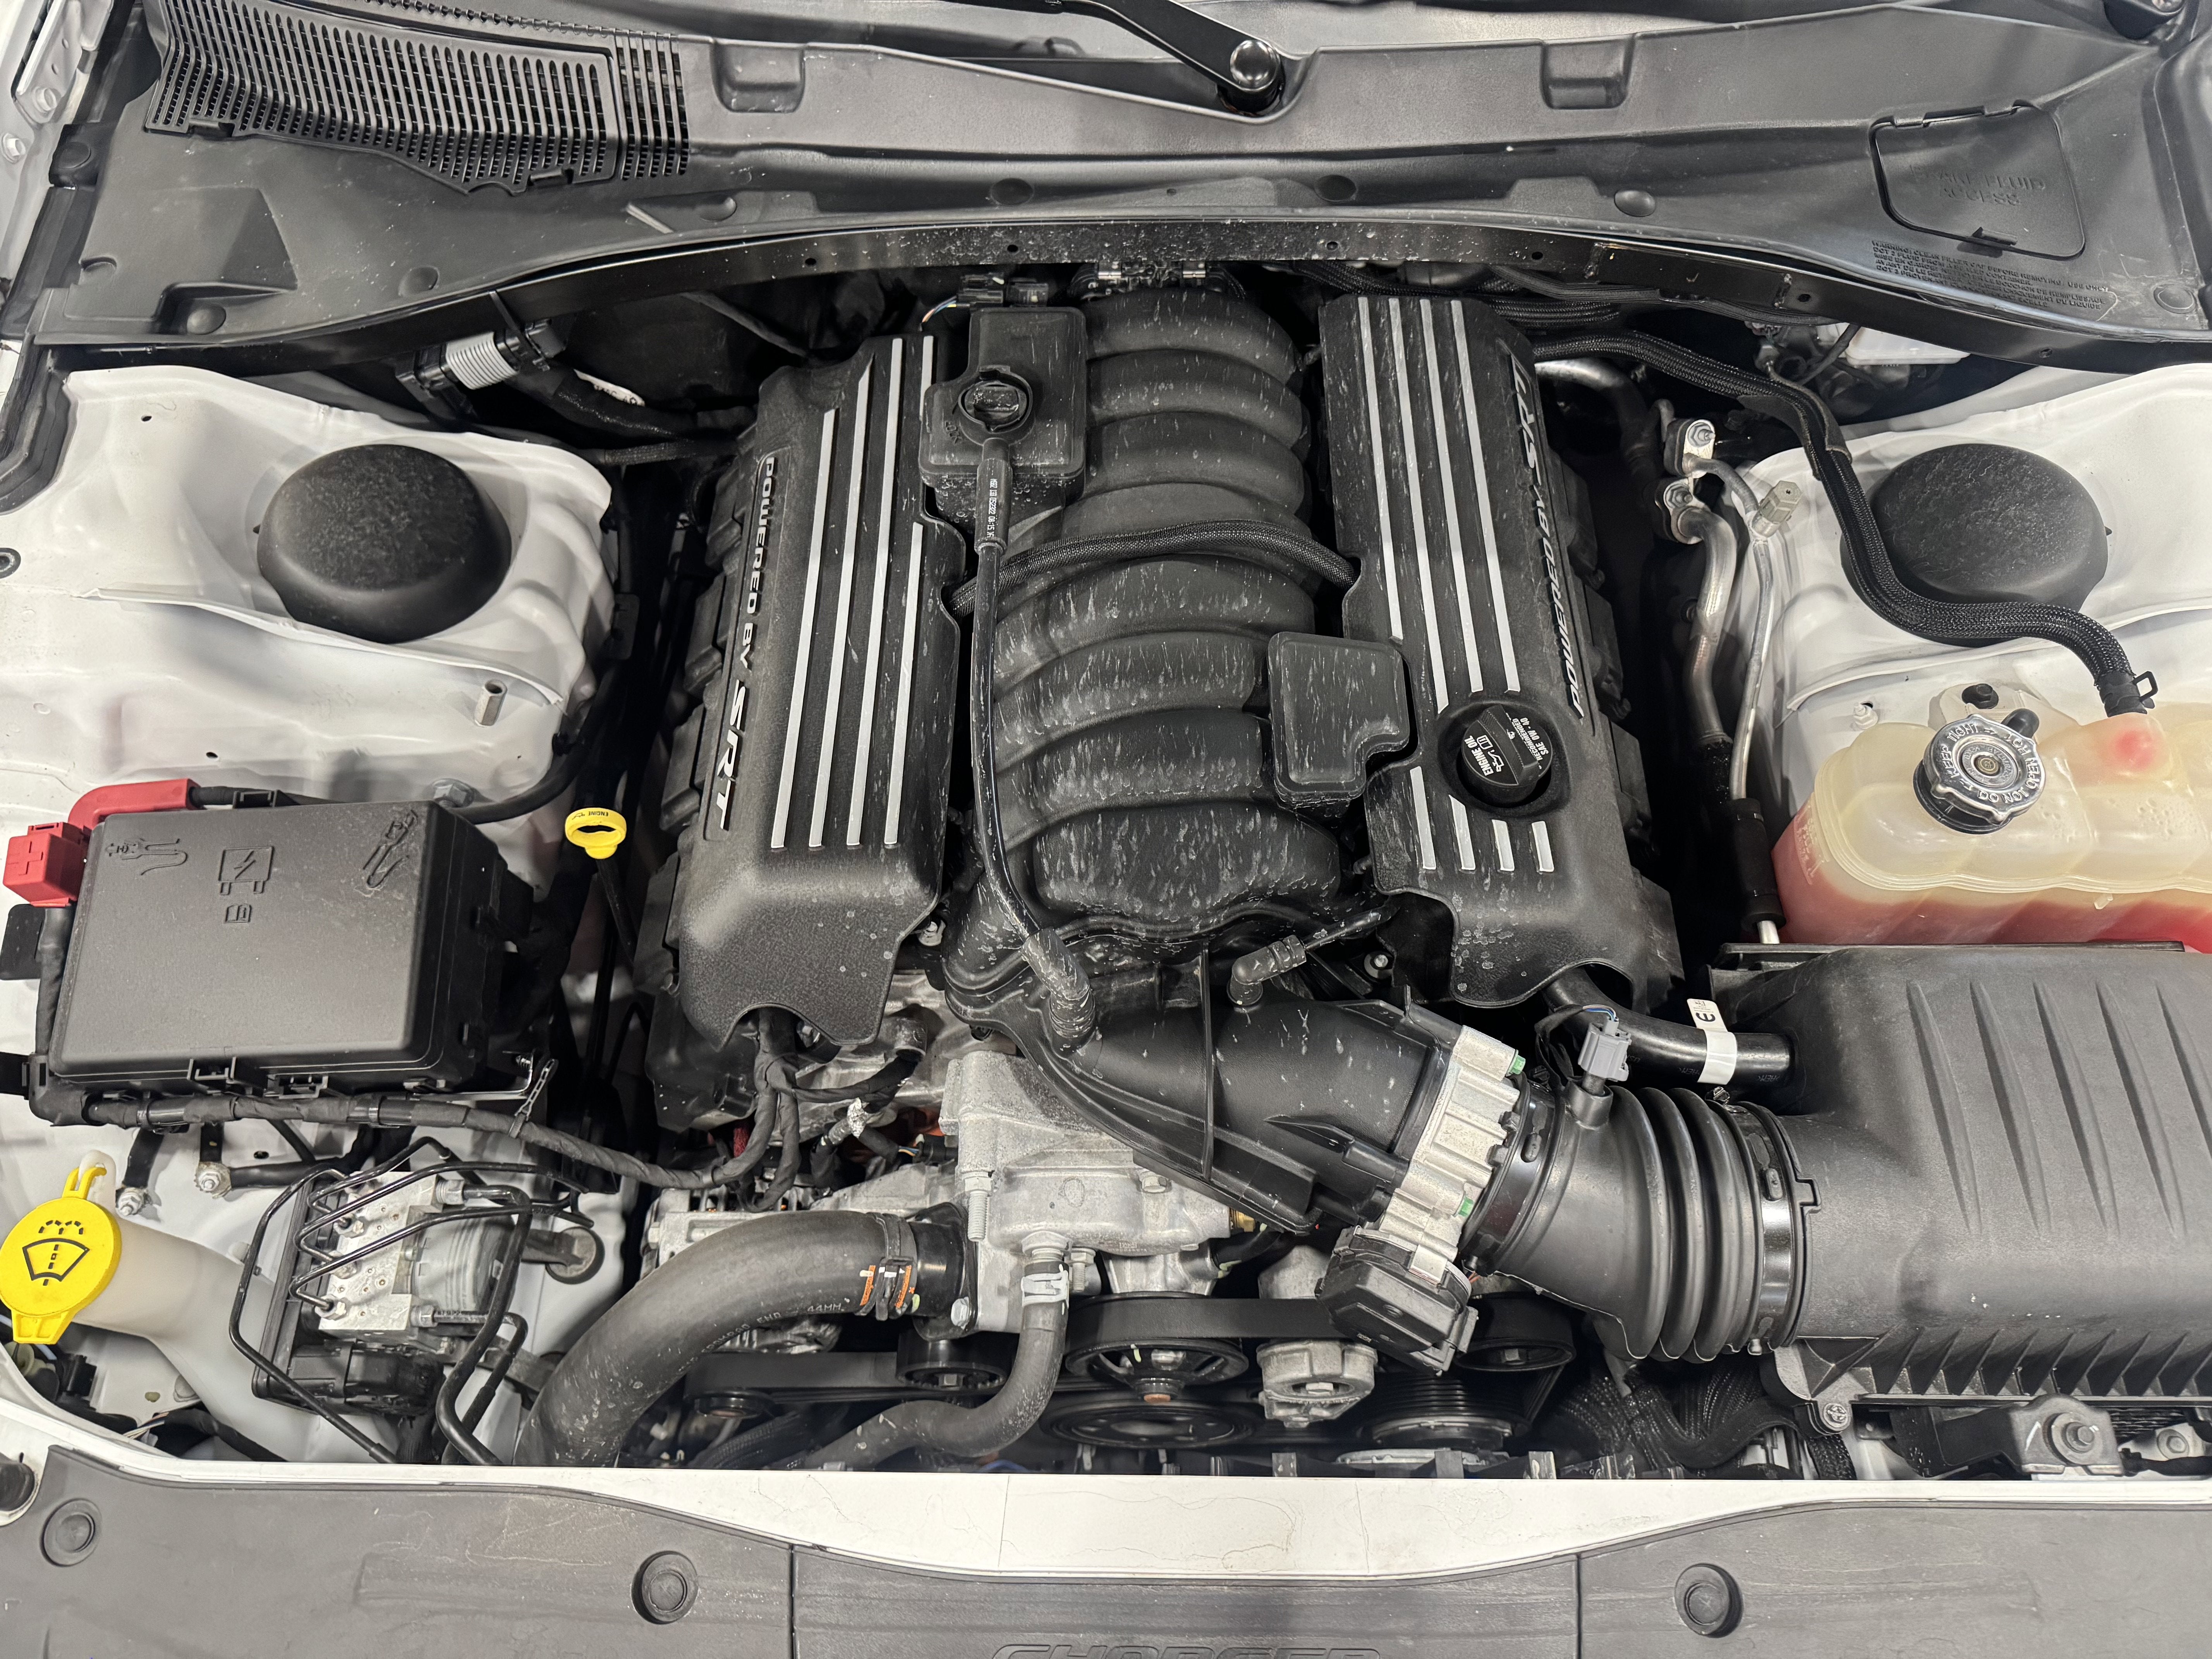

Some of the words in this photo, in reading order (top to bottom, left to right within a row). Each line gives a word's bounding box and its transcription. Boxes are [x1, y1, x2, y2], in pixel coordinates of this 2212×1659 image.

[1985, 175, 2045, 191] FLUID
[1939, 187, 2021, 206] ACCESS
[1922, 258, 1944, 266] FROM
[1987, 266, 2018, 276] BEFORE
[2069, 300, 2101, 310] LIQUIDE
[1510, 353, 1541, 486] SRT
[1533, 485, 1549, 537] BY
[747, 457, 775, 615] POWERED
[1542, 538, 1584, 718] POWERED
[740, 622, 754, 669] BY
[1464, 735, 1478, 749] OIL
[1512, 718, 1543, 761] RECOMMENDED
[1947, 723, 1979, 742] TIGHT
[2004, 732, 2031, 756] HOT
[717, 679, 746, 830] SRT
[1535, 742, 1549, 755] SAE
[1472, 749, 1494, 776] ENGINE
[1939, 745, 1960, 778] KEEP
[2025, 757, 2040, 790] OPEN
[1978, 790, 1999, 803] DO
[2004, 788, 2029, 804] NOT
